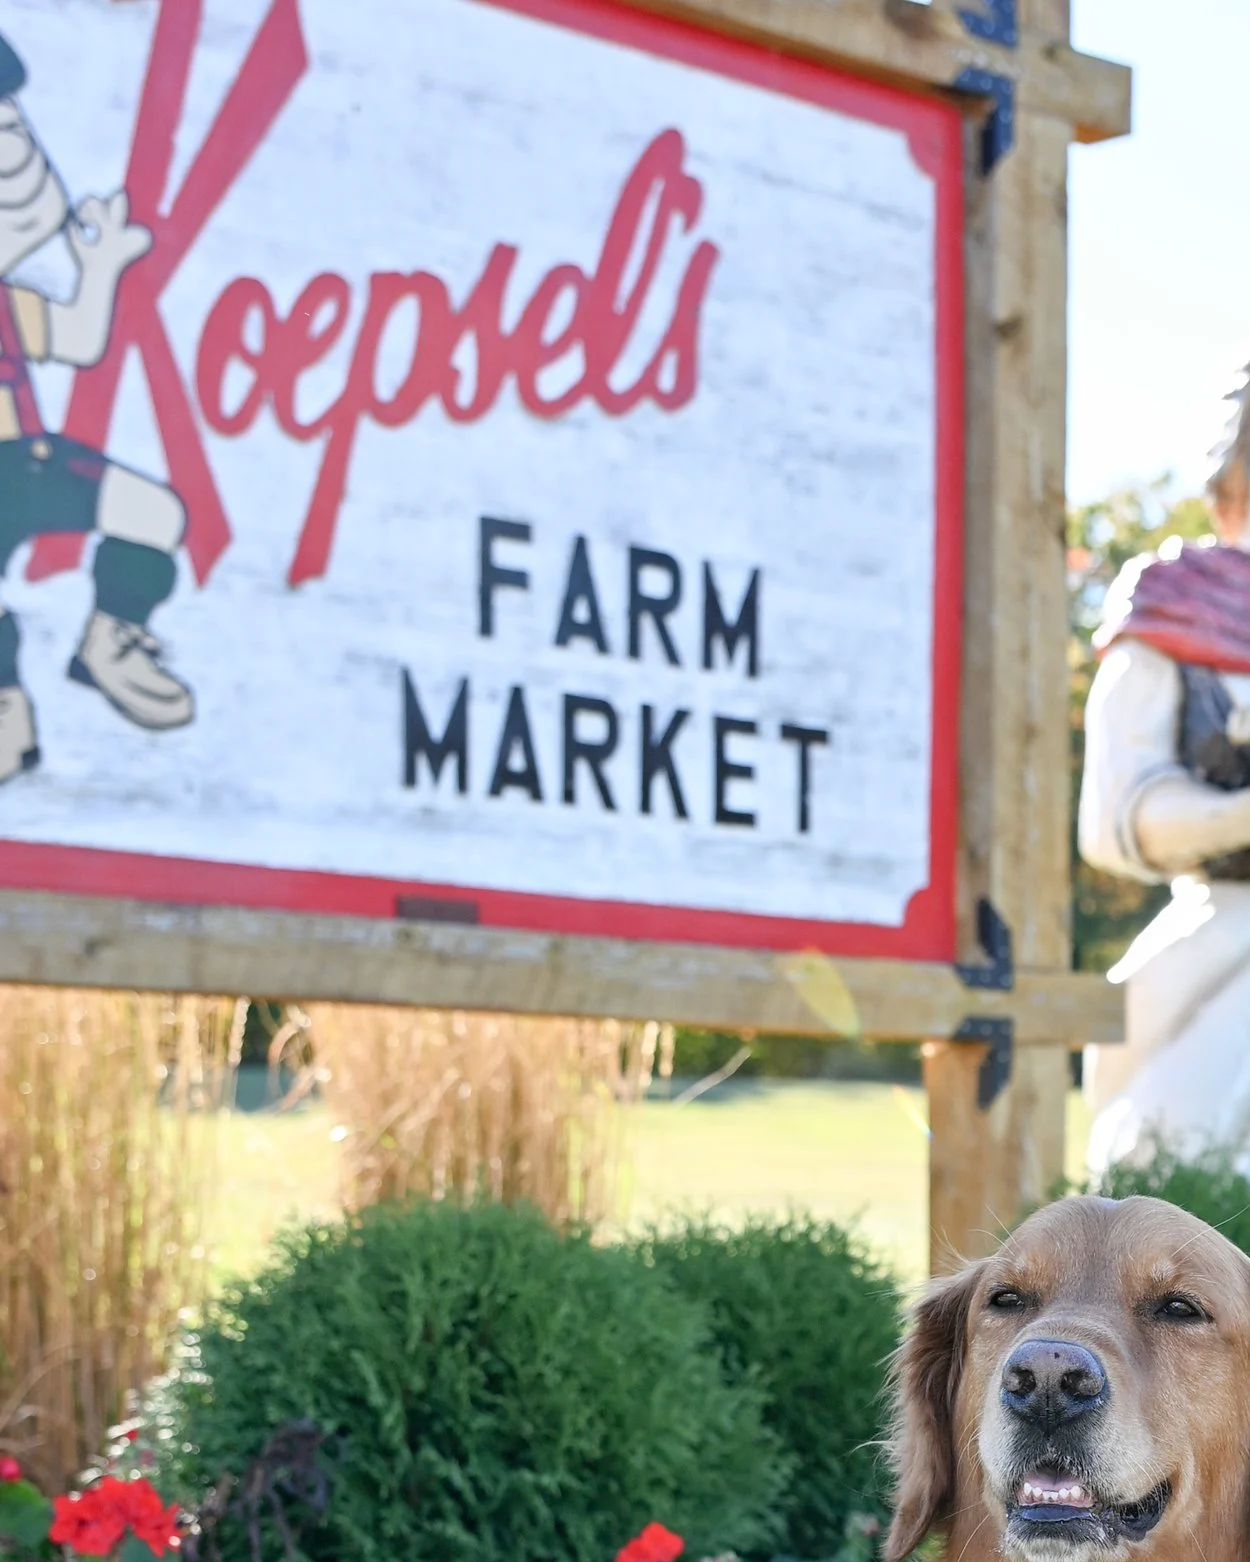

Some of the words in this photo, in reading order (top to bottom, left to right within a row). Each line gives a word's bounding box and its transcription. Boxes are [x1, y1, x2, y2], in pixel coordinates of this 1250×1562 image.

[25, 0, 720, 590] Koepsel's
[476, 515, 761, 679] FARM
[401, 666, 830, 834] MARKET
